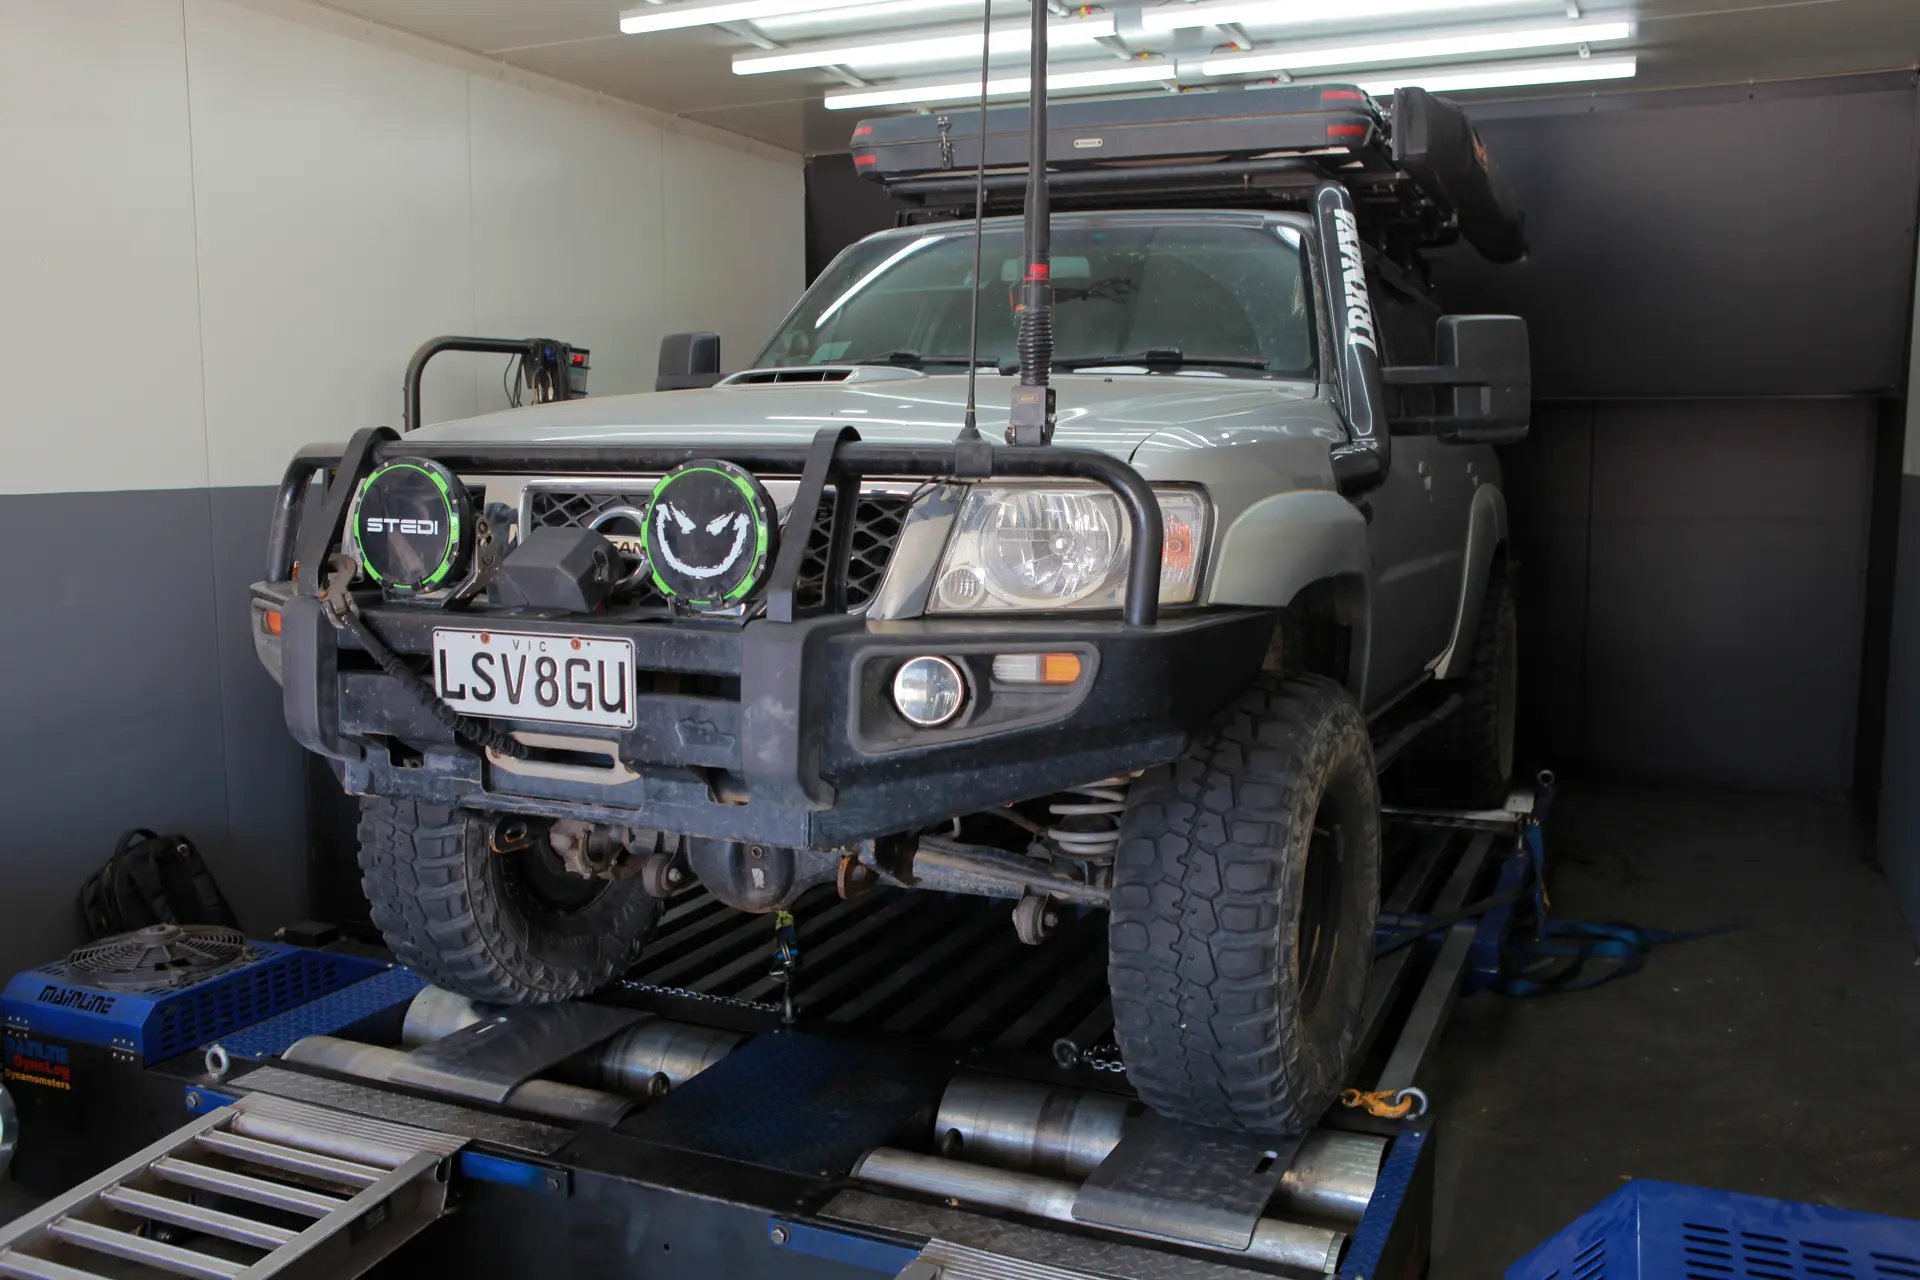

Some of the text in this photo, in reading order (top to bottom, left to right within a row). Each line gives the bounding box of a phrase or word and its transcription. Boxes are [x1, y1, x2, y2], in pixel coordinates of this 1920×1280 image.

[367, 517, 439, 535] STEDI
[439, 649, 627, 714] LSV8GU
[5, 1067, 71, 1090] Dynamometers
